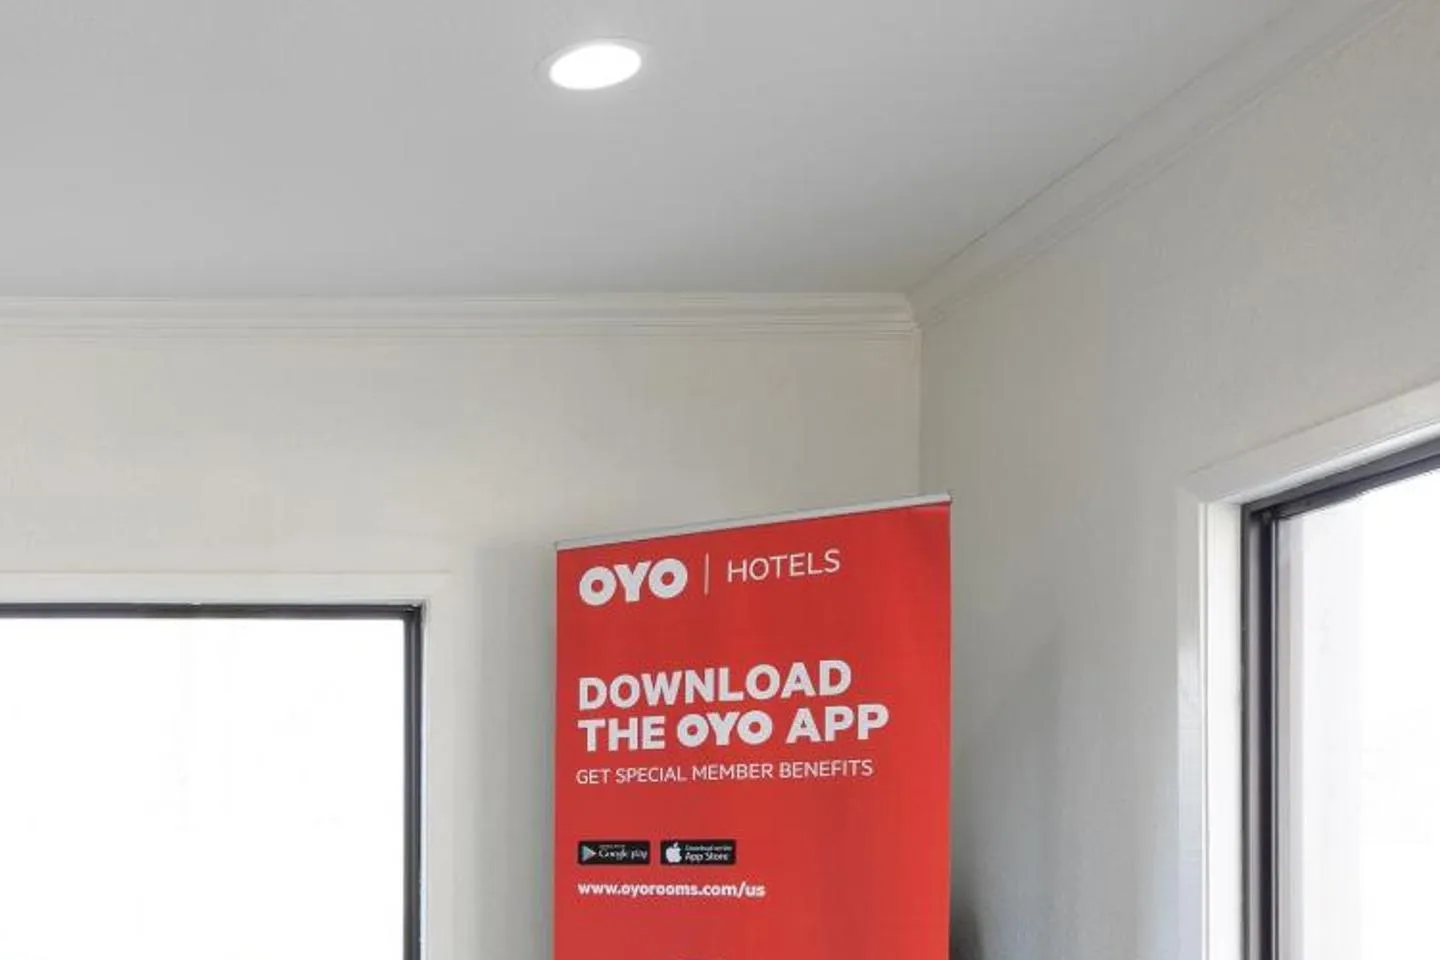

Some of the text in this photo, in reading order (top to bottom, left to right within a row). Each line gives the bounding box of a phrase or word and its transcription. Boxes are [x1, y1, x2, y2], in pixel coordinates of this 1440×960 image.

[578, 548, 841, 607] OYO HOTELS
[578, 659, 852, 711] DOWNLOAD
[577, 703, 890, 753] THE OYO APP
[575, 759, 874, 785] GET SPECIAL MEMBER BENEFITS
[598, 848, 628, 861] Google
[685, 851, 729, 863] App Store
[577, 880, 767, 899] www.oyorooms.com/us
